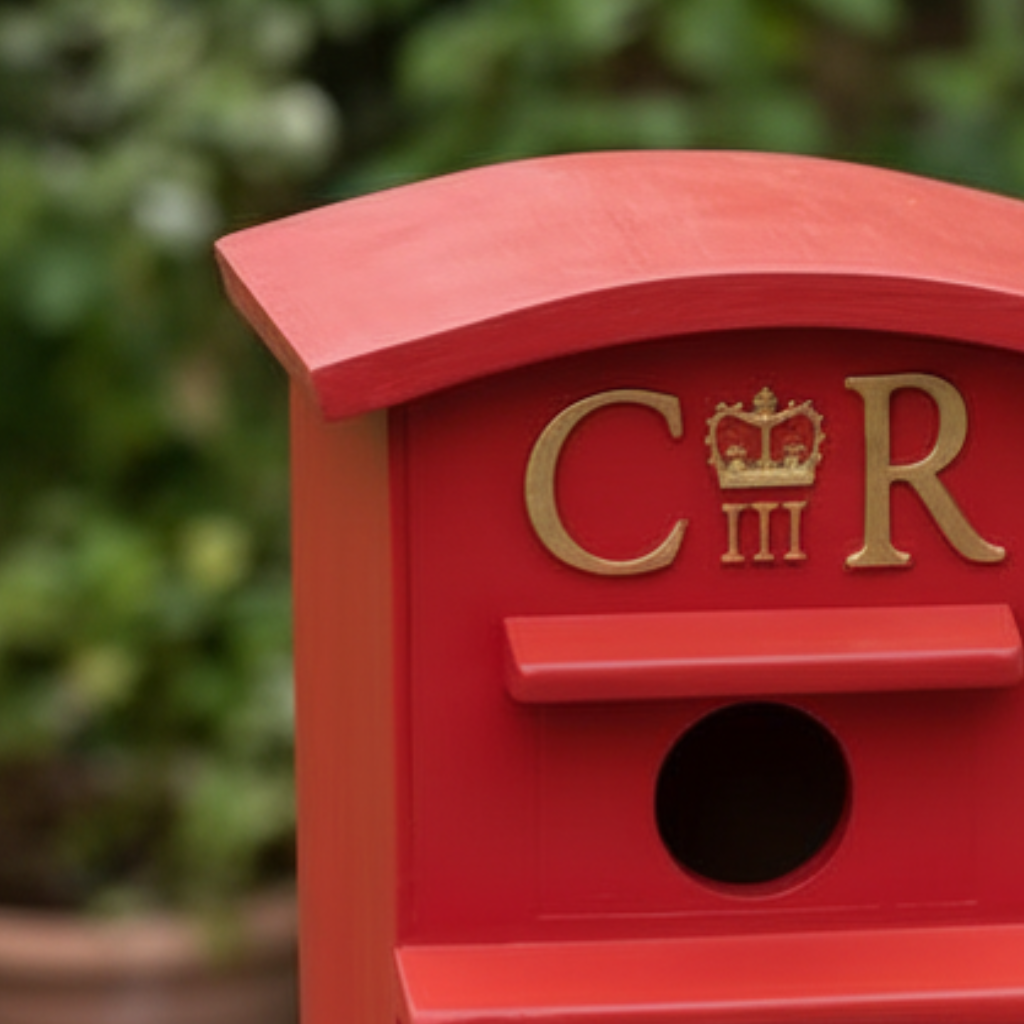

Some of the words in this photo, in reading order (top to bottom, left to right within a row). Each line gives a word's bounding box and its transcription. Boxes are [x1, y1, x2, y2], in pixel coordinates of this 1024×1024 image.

[524, 389, 688, 576] C
[721, 501, 807, 566] III
[844, 373, 1006, 571] R
